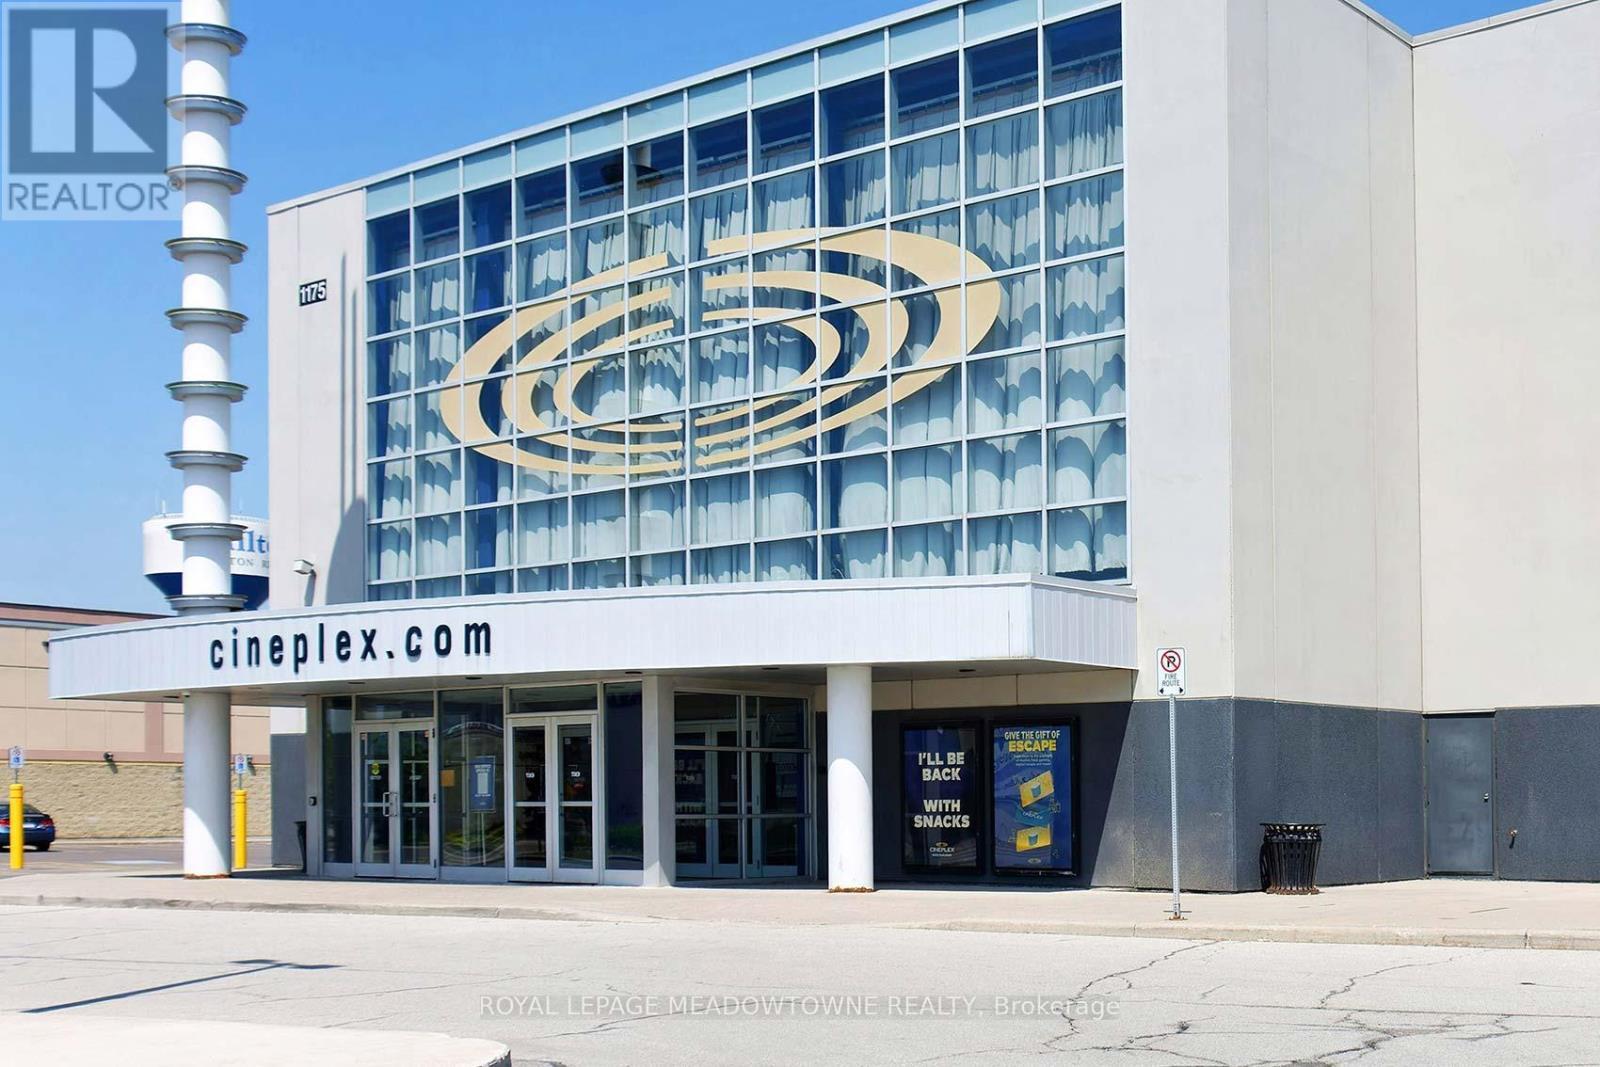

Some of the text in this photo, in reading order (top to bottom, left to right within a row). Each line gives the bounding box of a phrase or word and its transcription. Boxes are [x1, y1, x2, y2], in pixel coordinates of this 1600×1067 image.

[300, 281, 326, 303] 1175
[210, 622, 491, 674] cineplex.com
[1004, 730, 1060, 740] GIVE THE GIFT OF
[1008, 740, 1057, 752] ESCAPE
[918, 752, 965, 765] I'LL BE
[922, 768, 961, 781] BACK
[923, 799, 961, 812] WITH
[914, 815, 970, 828] SNACKS
